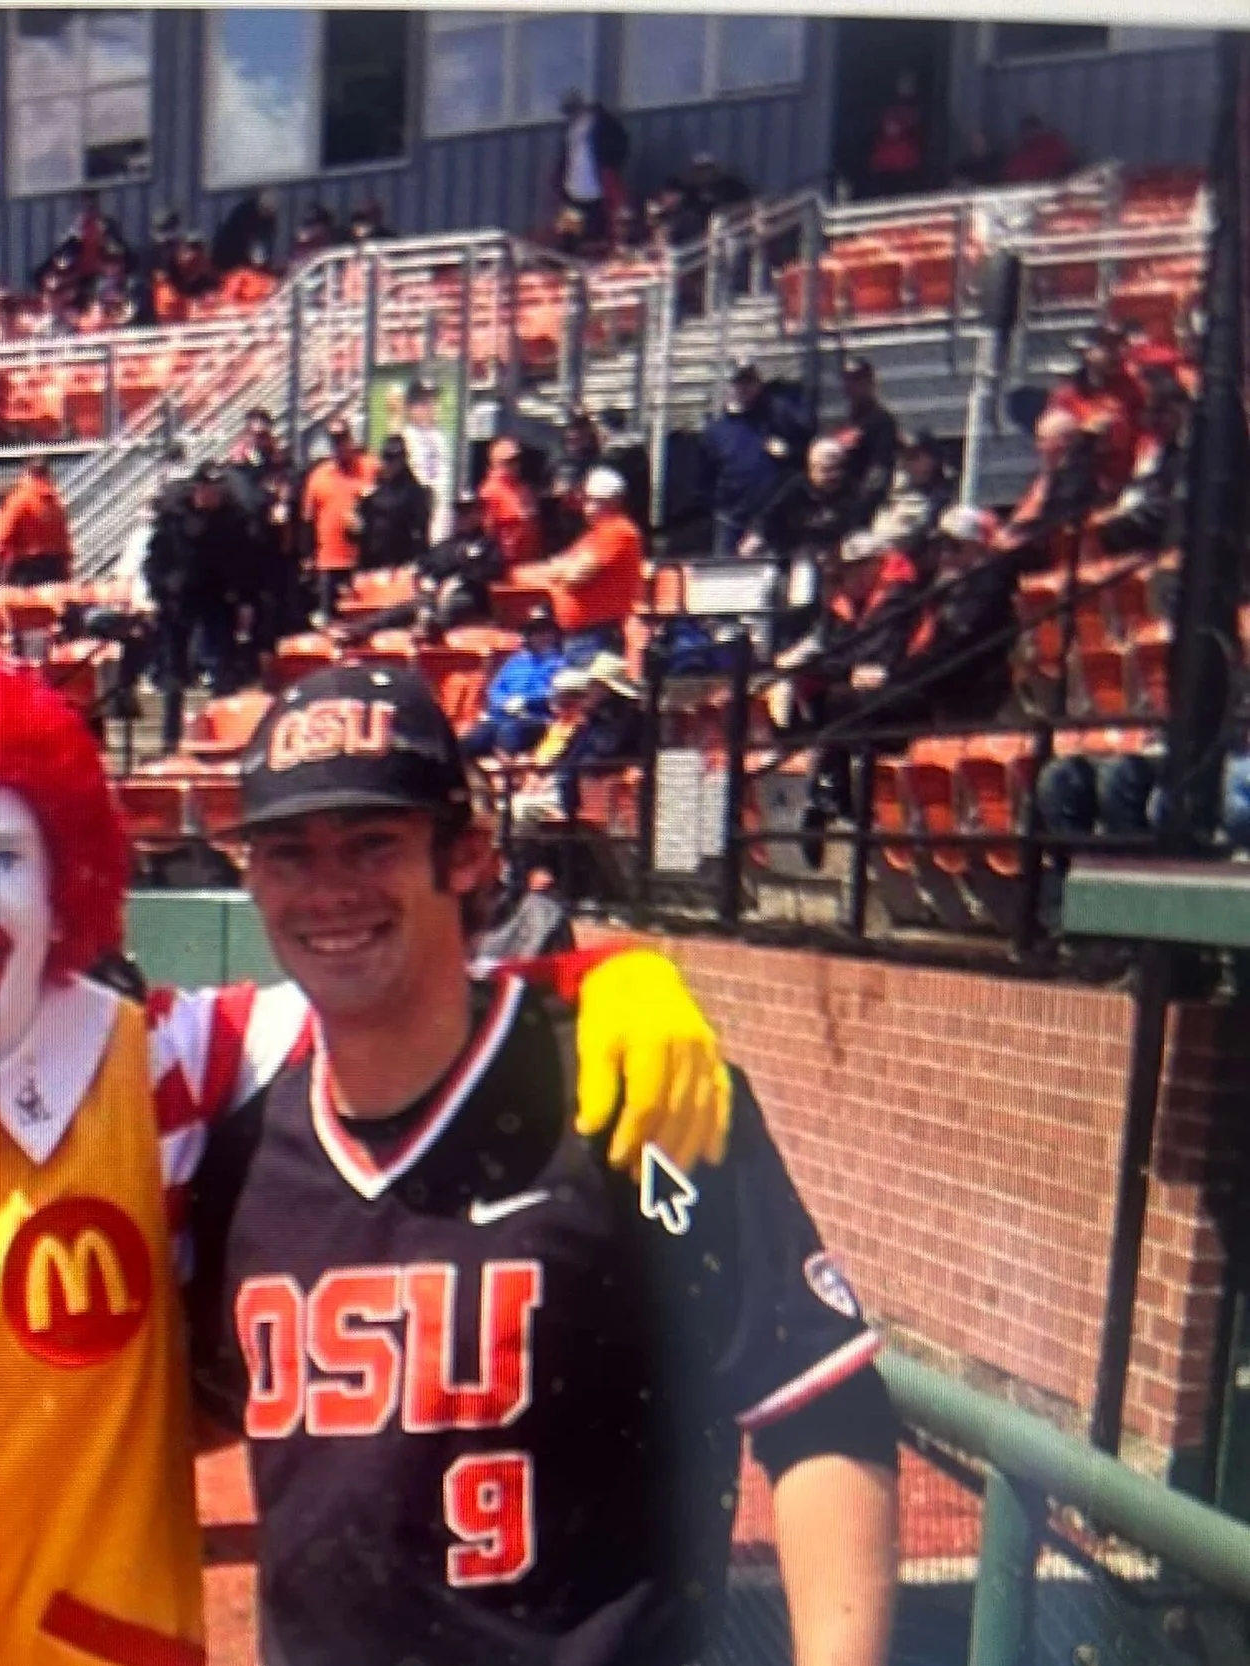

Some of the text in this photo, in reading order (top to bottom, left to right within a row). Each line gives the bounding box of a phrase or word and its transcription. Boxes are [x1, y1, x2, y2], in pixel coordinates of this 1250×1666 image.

[267, 699, 397, 772] OSU
[234, 1259, 543, 1438] OSU
[443, 1452, 536, 1587] 9
